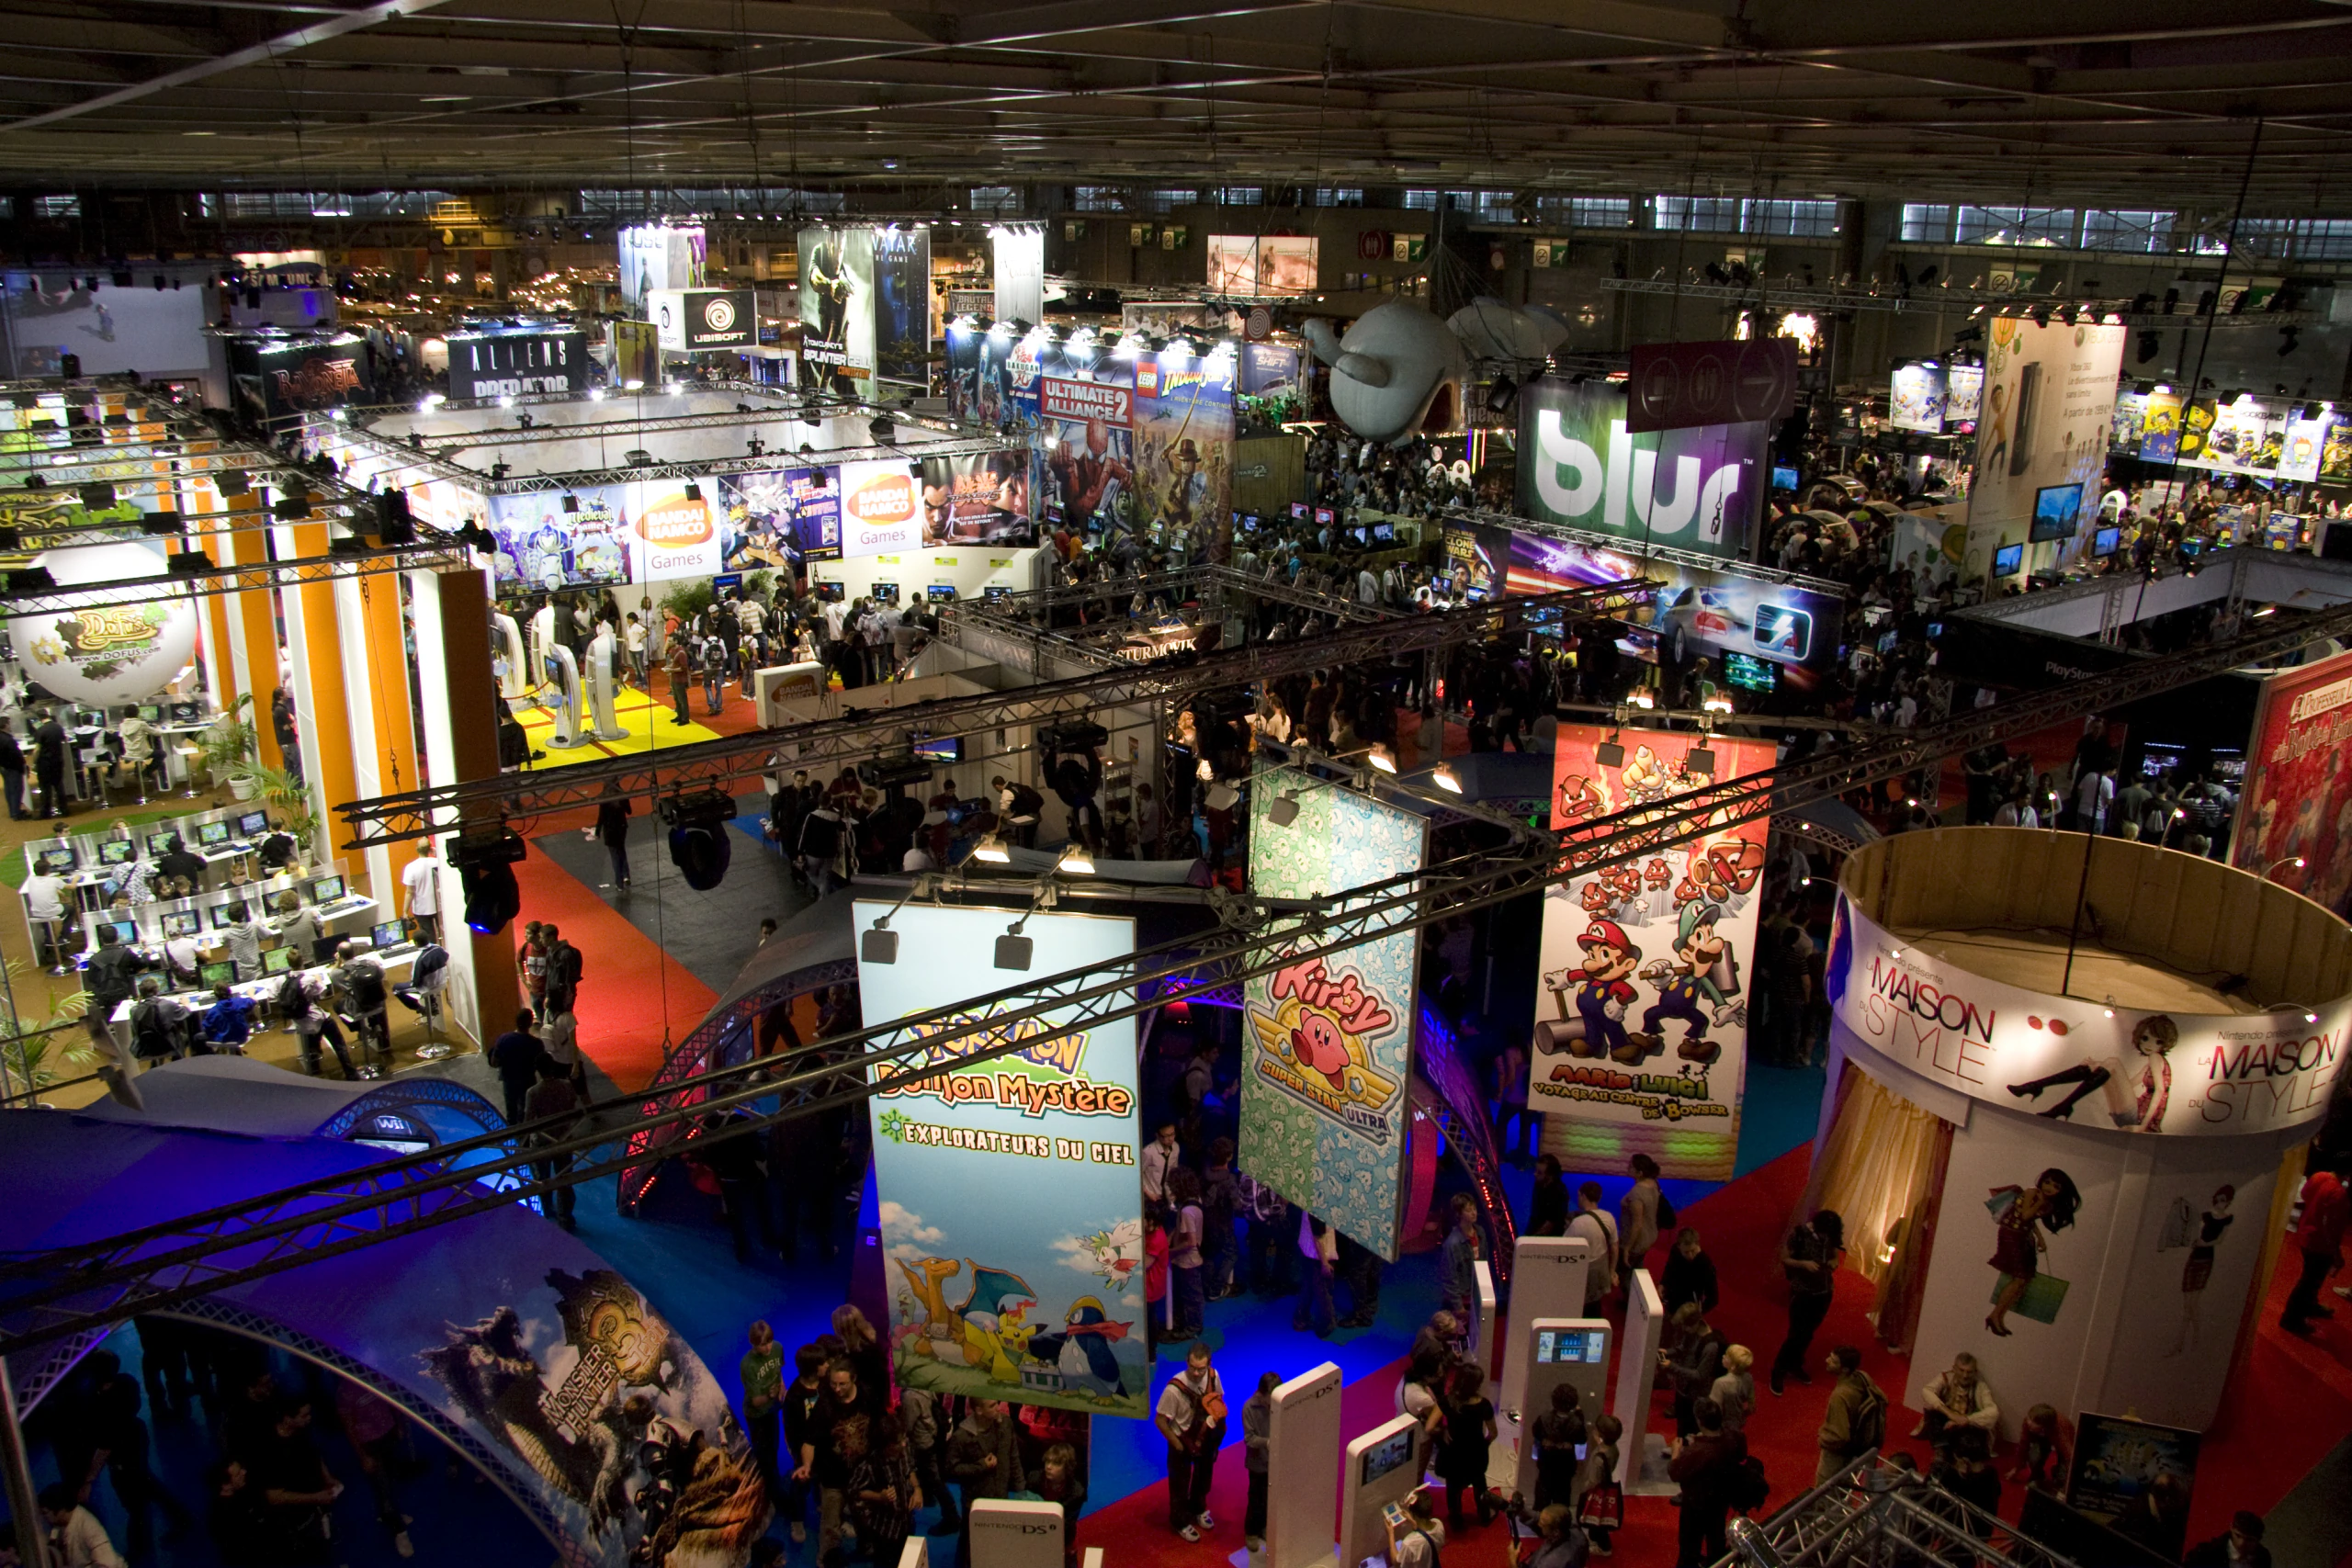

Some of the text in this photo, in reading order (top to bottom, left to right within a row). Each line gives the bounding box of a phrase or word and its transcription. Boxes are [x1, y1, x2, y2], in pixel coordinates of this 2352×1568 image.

[871, 233, 916, 254] VATAR
[695, 333, 745, 343] UBISOFT
[469, 341, 567, 372] ALIENS
[804, 349, 847, 367] SPLINTER
[1136, 371, 1157, 388] LEGO
[1221, 373, 1233, 392] 2
[1046, 380, 1128, 423] ULTIMATE 2
[1046, 398, 1115, 422] ALLIANCE
[1535, 409, 1740, 545] blur
[858, 487, 909, 502] BANDAI
[648, 507, 705, 526] BANDAI
[859, 501, 909, 517] NAMCO
[649, 521, 706, 539] NAMCO
[860, 530, 906, 545] Games
[651, 553, 702, 569] Games
[1447, 545, 1475, 558] WARS
[73, 646, 162, 663] www.DOFUS.com
[1272, 949, 1393, 1036] Kirby
[1871, 956, 1996, 1043] MAISON
[1866, 993, 1989, 1085] STYLE
[2217, 1031, 2264, 1040] Nintendo
[2209, 1029, 2340, 1079] MAISON
[996, 1073, 1130, 1113] Mystère
[1261, 1057, 1342, 1114] SUPER STAR
[1534, 1082, 1589, 1101] VOYAGE
[1610, 1091, 1660, 1107] CENTRE
[1640, 1072, 1710, 1100] LUIGI
[2201, 1066, 2332, 1123] STYLE
[377, 1118, 404, 1129] Wii
[1344, 1105, 1388, 1132] ULTRA
[1642, 1108, 1661, 1120] DE
[902, 1122, 1135, 1167] EXPLORATEURS DU CIEL
[757, 1358, 781, 1381] IRISH
[540, 1343, 605, 1426] MONSTER
[564, 1360, 617, 1437] HUNTER
